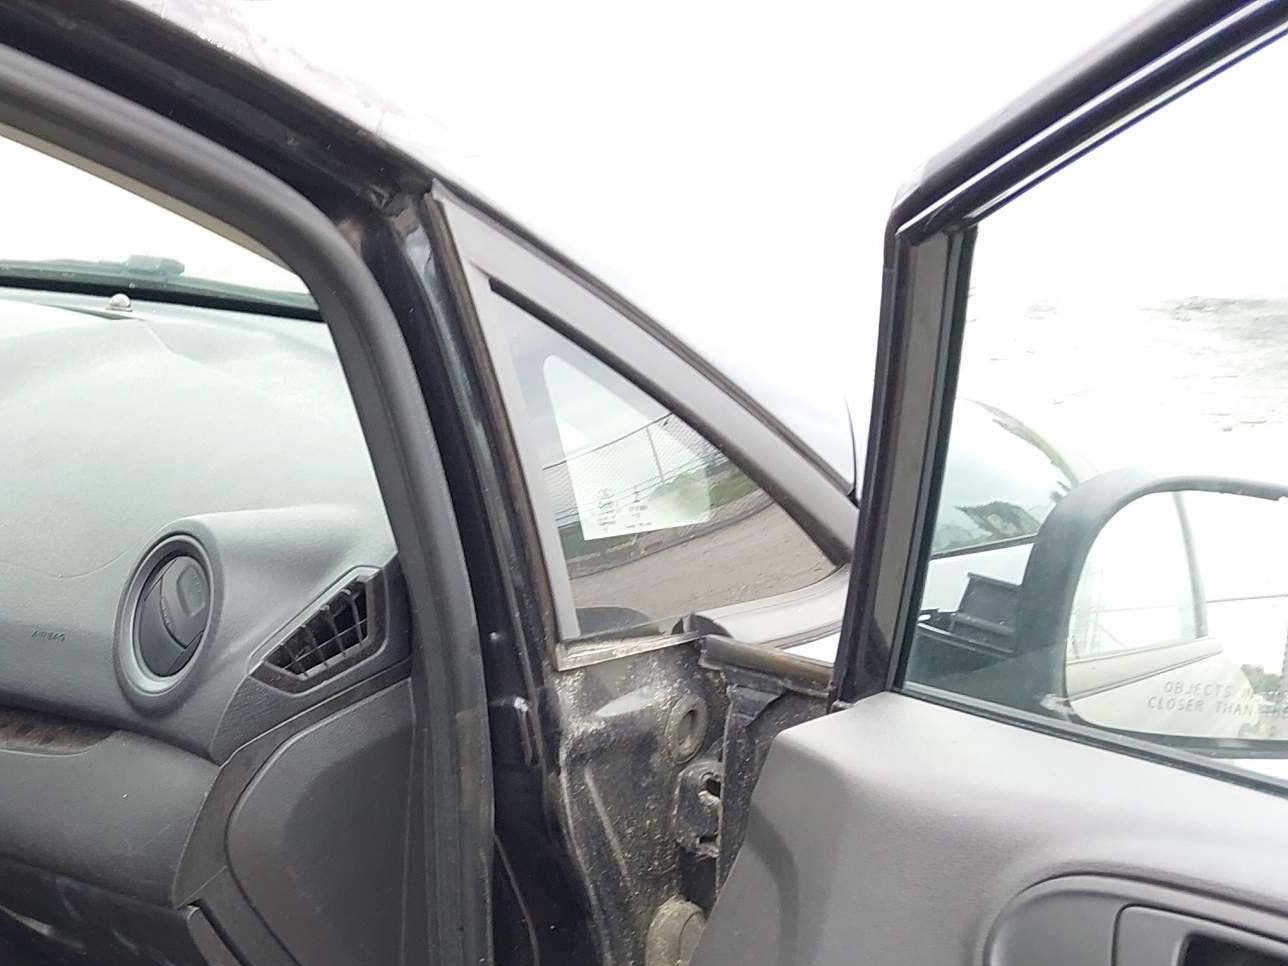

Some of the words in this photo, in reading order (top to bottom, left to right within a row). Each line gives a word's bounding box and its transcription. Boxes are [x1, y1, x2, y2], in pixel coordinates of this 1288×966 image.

[1164, 681, 1232, 698] OBJECTS
[1148, 696, 1204, 712] CLOSER
[1216, 701, 1253, 716] THAN
